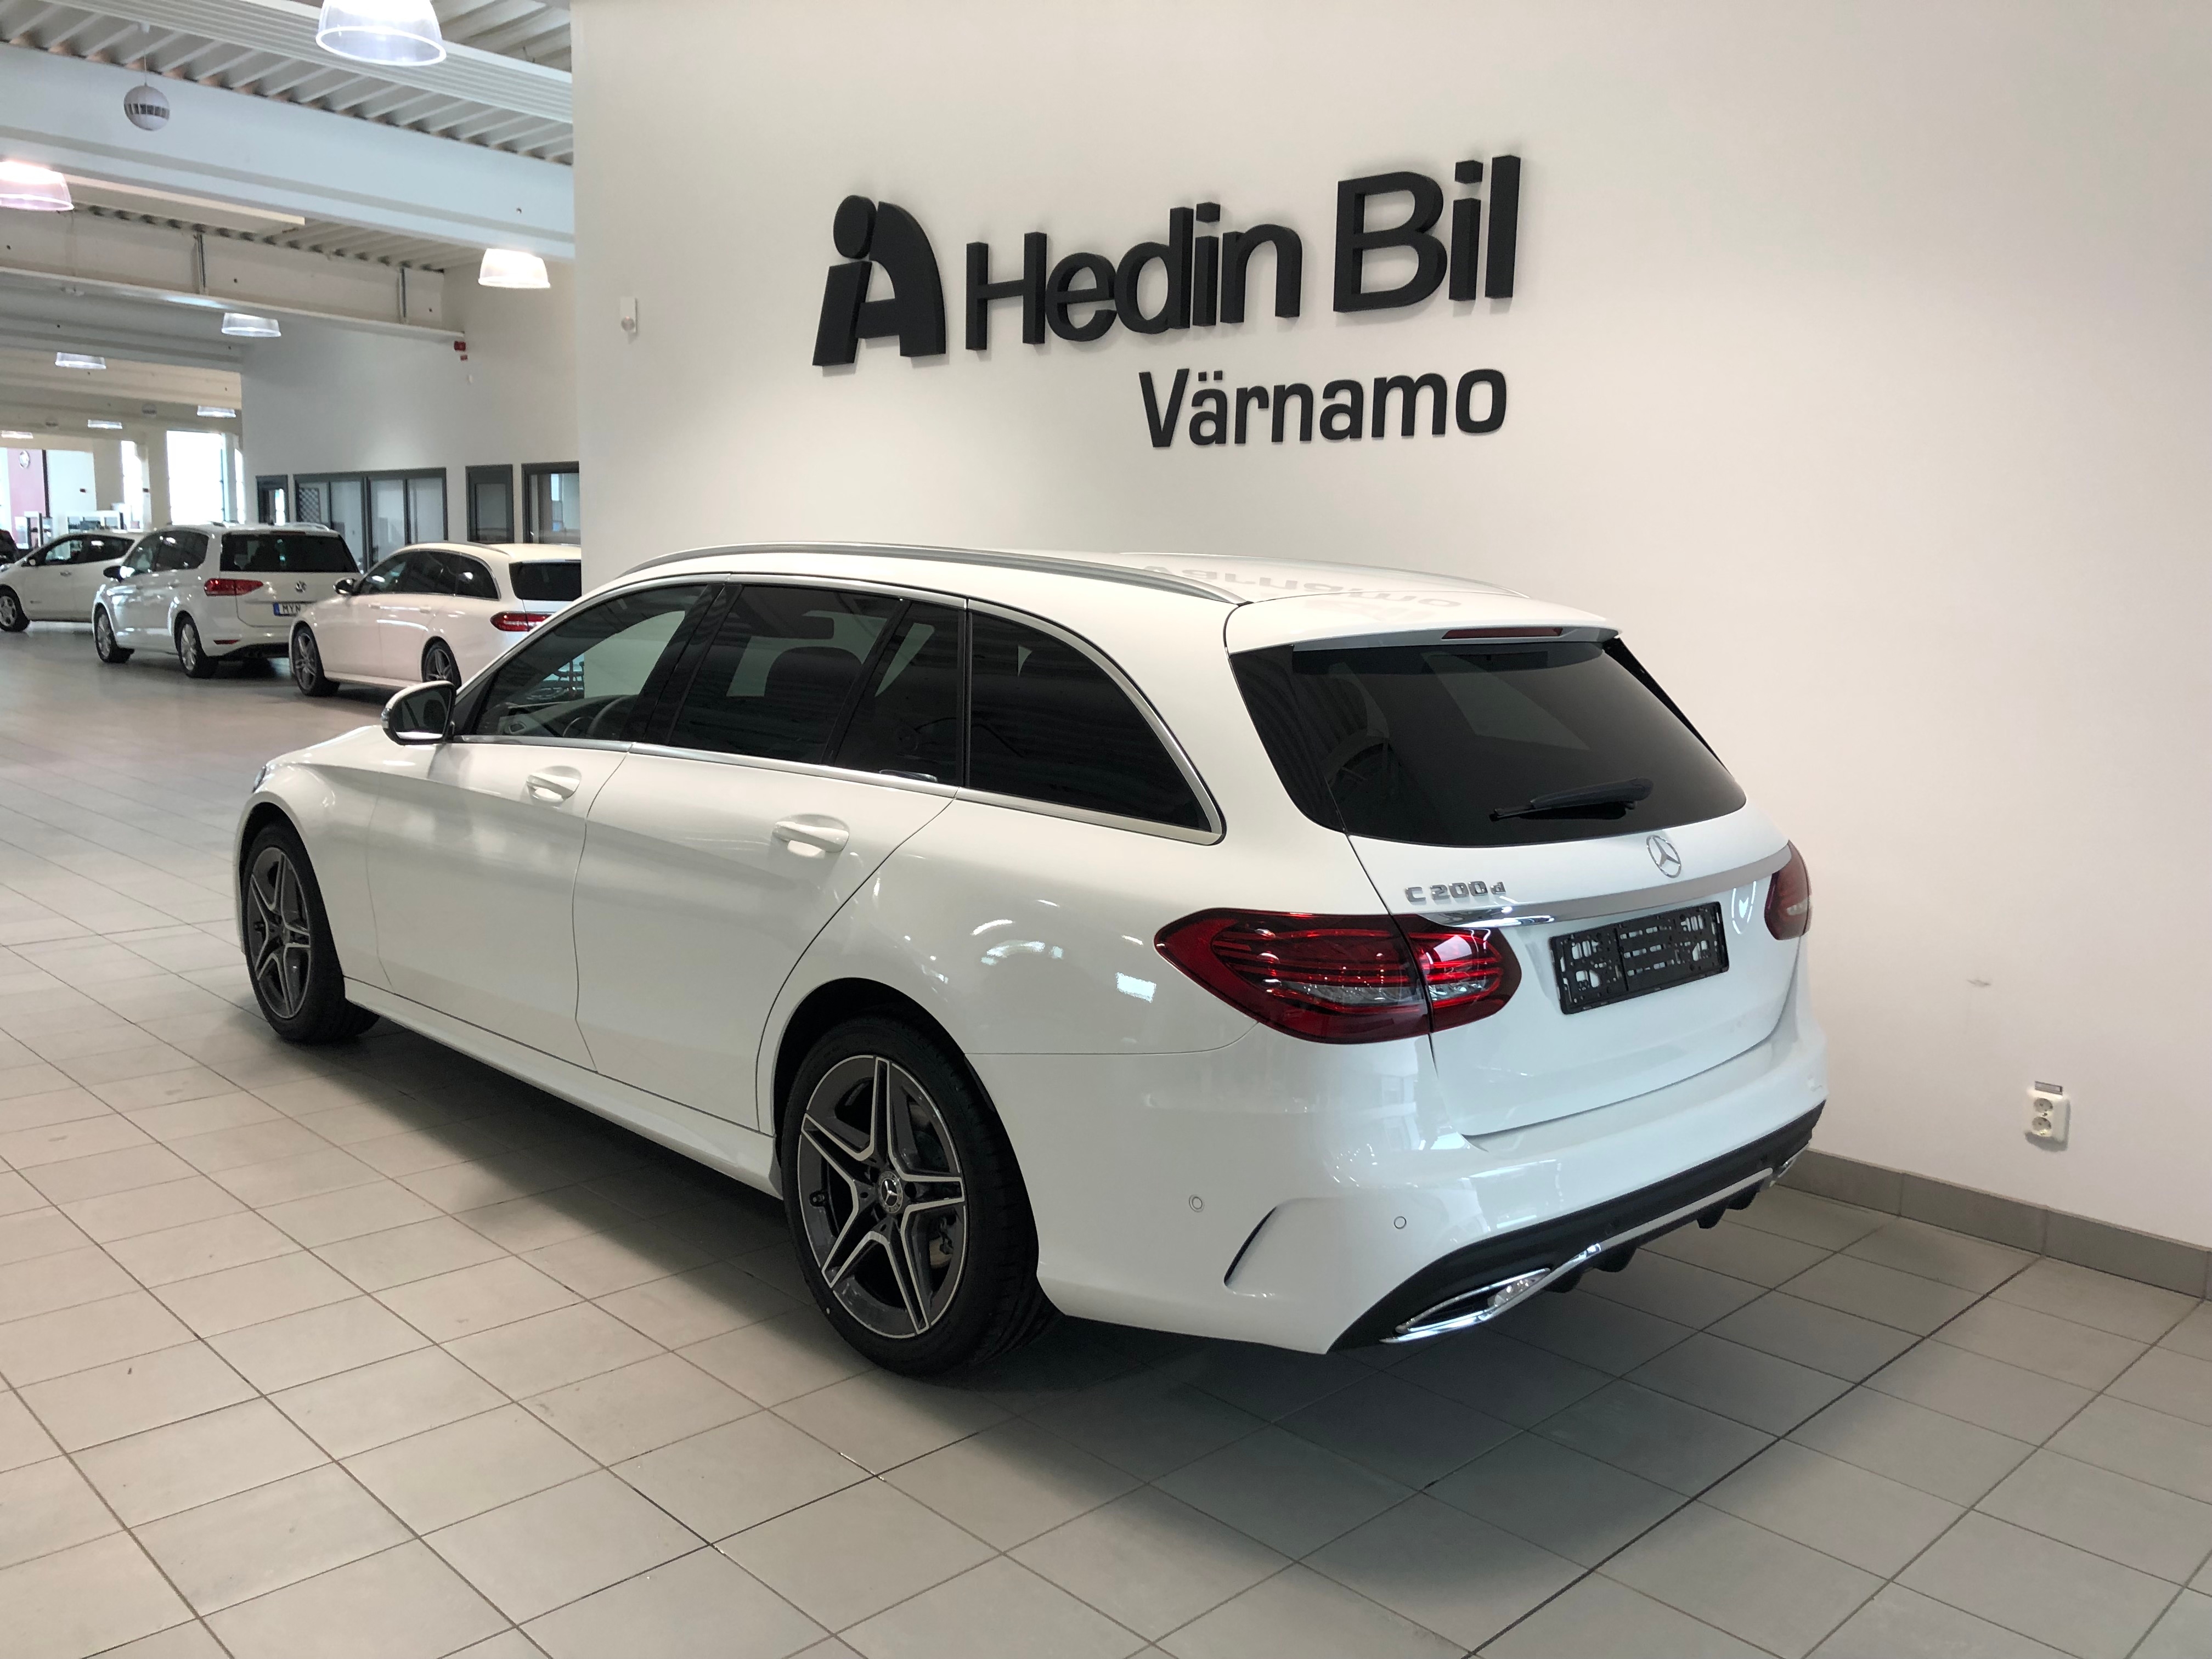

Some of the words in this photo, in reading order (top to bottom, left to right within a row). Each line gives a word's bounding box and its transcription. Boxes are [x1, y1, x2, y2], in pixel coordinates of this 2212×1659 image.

[966, 201, 1303, 351] Hedin
[1333, 155, 1521, 313] Bil
[1138, 368, 1507, 448] Värnamo
[1405, 887, 1426, 903] C
